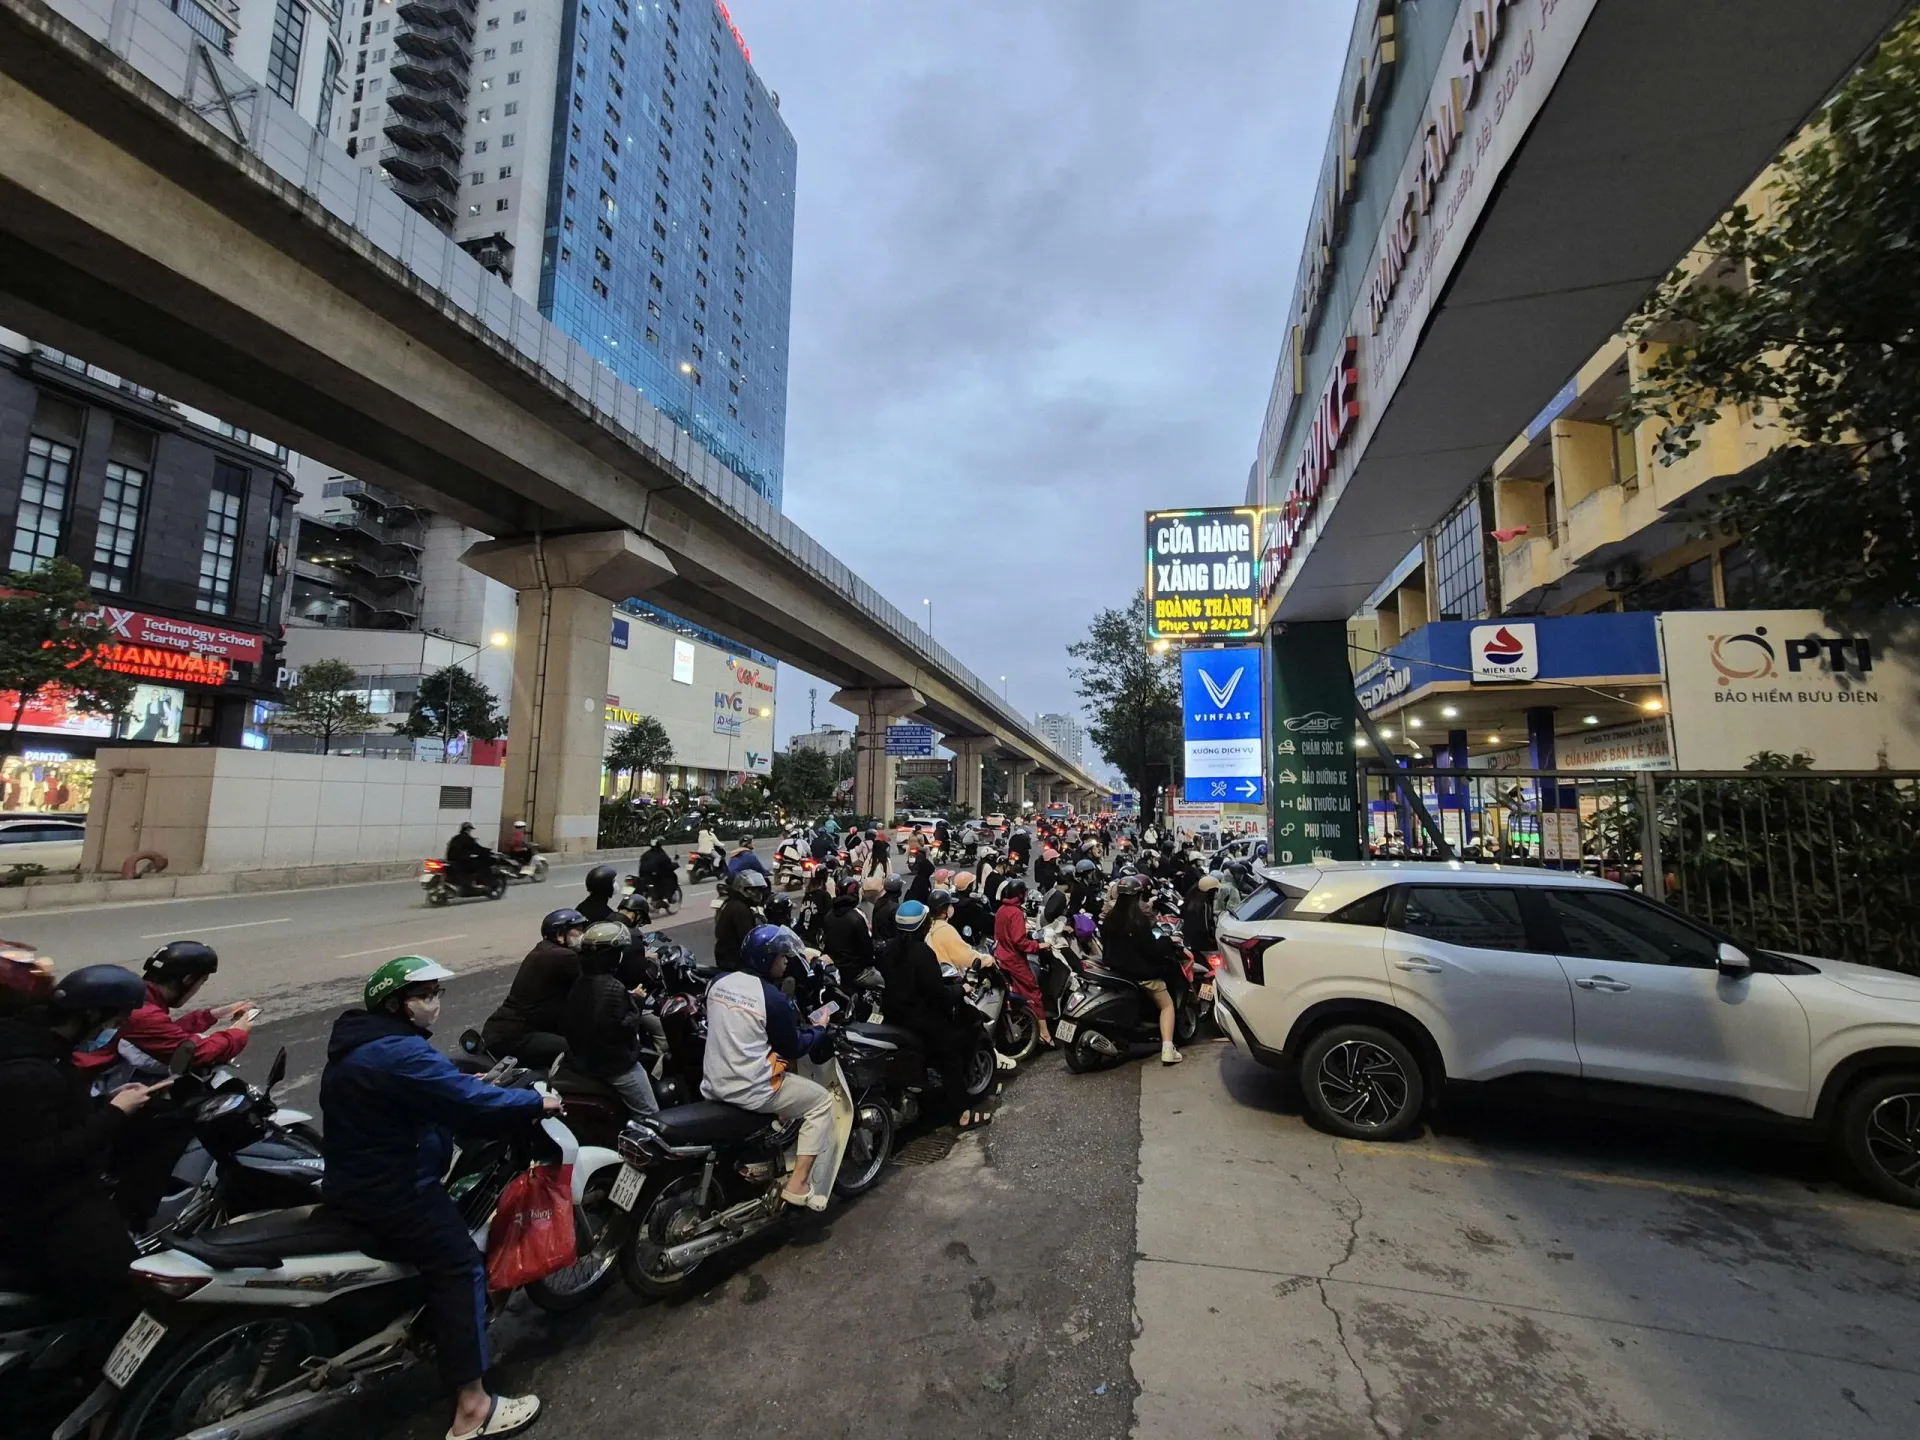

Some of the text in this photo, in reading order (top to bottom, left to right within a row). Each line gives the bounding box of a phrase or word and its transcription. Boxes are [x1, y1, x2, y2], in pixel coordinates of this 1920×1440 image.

[1367, 191, 1417, 336] TRUNG
[1157, 519, 1250, 554] CỬA HÀNG
[1157, 555, 1250, 592] XĂNG DẦU
[1155, 593, 1252, 618] HOÀNG THÀNH
[143, 617, 255, 648] Technology School
[1158, 618, 1249, 633] Phục vụ 24/24
[140, 631, 227, 655] Startup Space
[1785, 638, 1873, 672] PTI
[97, 661, 223, 686] AIWANESE HOTPOT
[277, 667, 300, 690] PA
[1714, 688, 1878, 705] BẢO HIỂM BƯU ĐIỆN
[1194, 711, 1251, 722] VINFAST
[1221, 746, 1241, 756] DỊCH
[1302, 740, 1344, 755] CHĂM SÓC XE
[1338, 770, 1347, 785] XE
[1245, 821, 1258, 833] GA
[1304, 820, 1340, 840] PHỤ TÙNG
[368, 975, 394, 998] Grab
[612, 1184, 634, 1208] 8130
